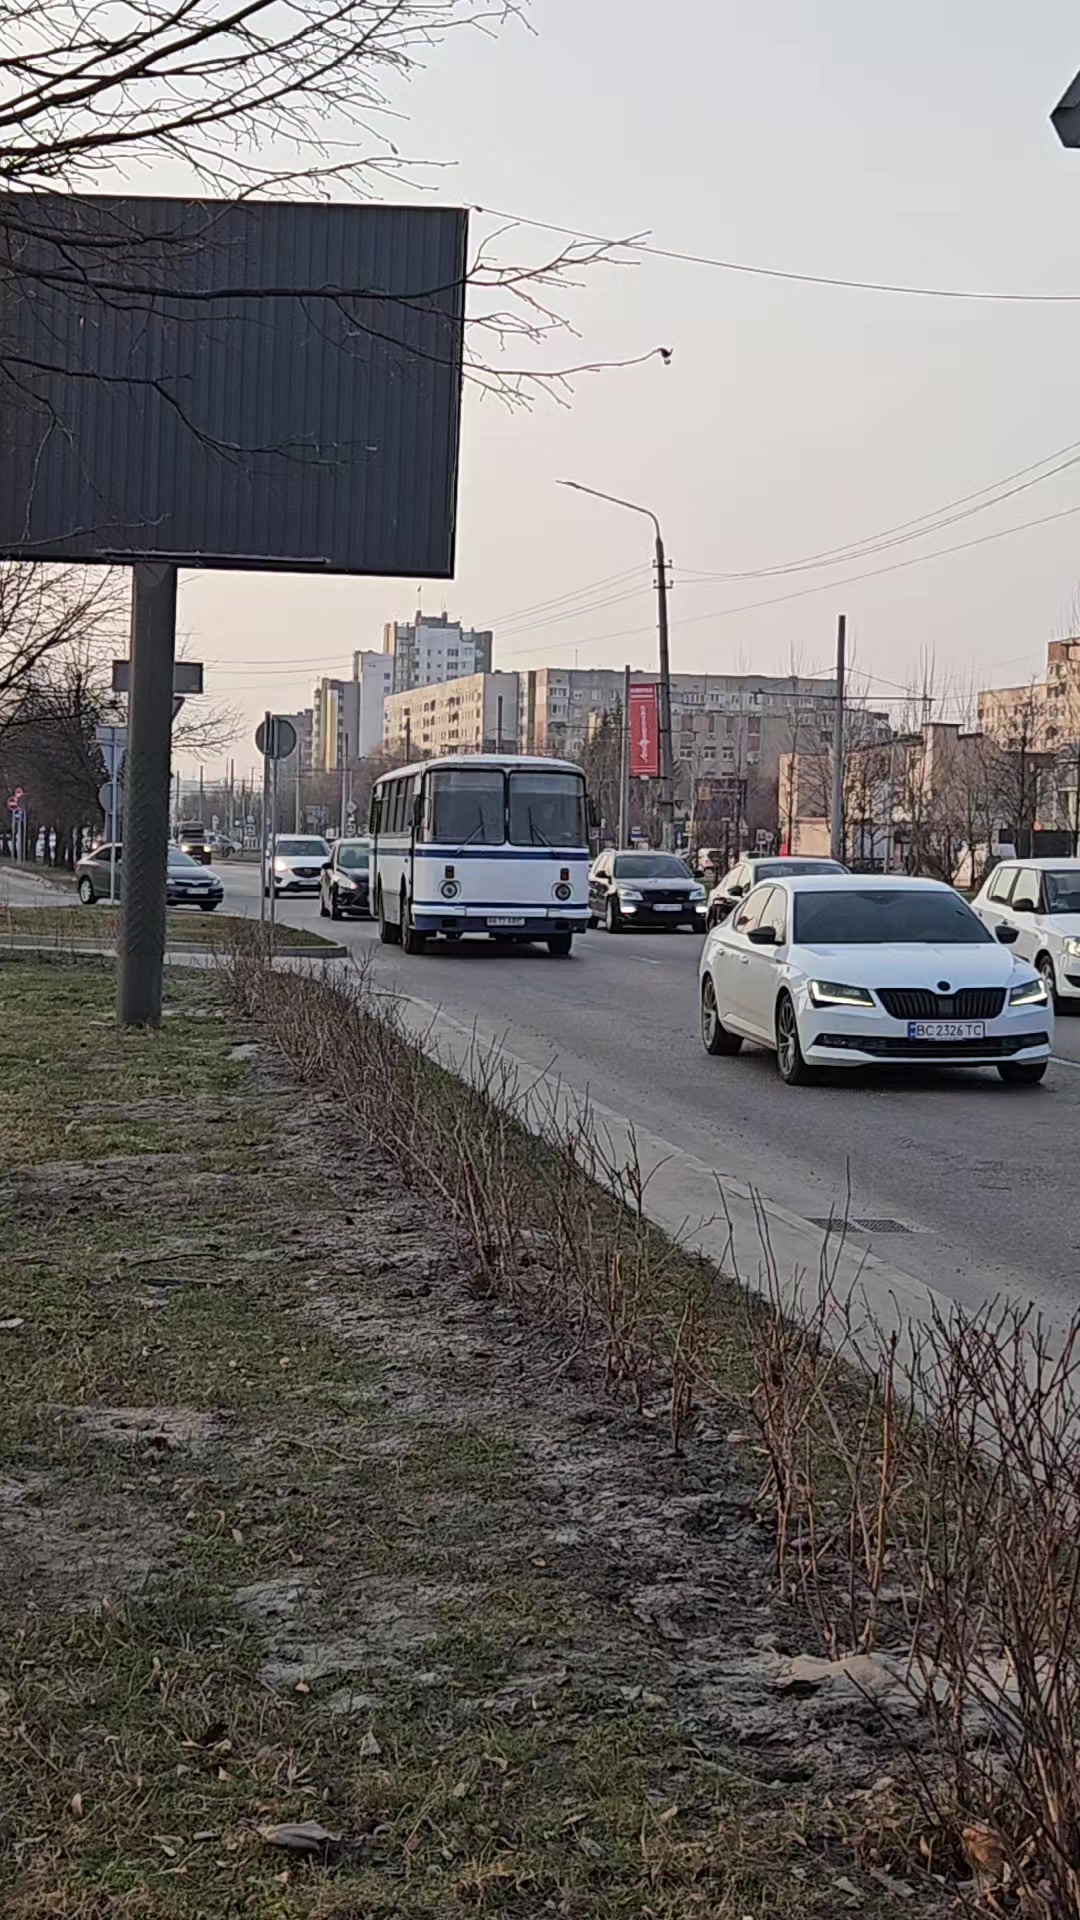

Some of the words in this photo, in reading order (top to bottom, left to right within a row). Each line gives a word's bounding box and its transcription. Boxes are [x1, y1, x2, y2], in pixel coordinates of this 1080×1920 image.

[916, 1024, 934, 1036] BC
[936, 1024, 963, 1036] 2326
[965, 1024, 982, 1036] TC
